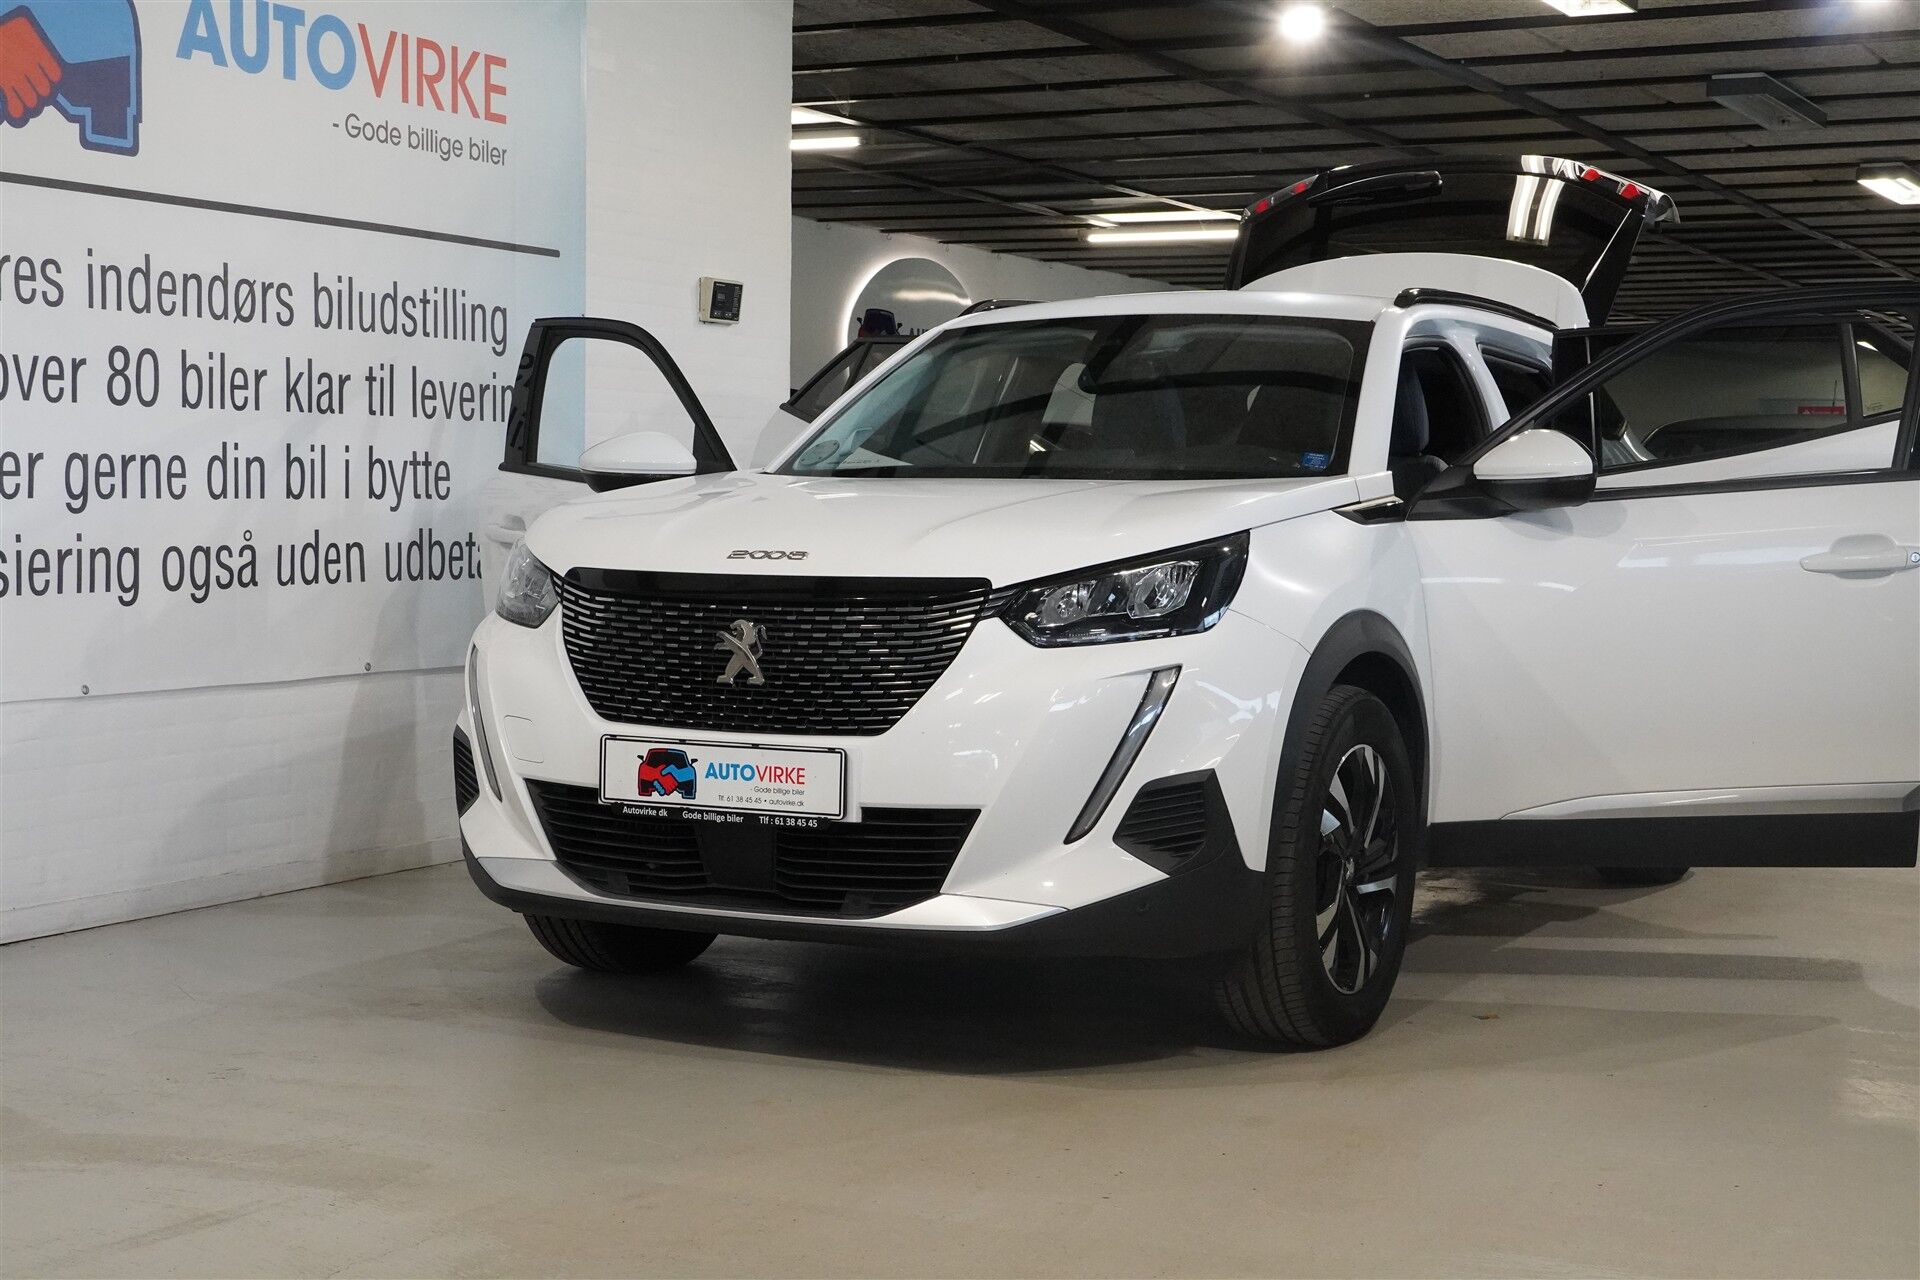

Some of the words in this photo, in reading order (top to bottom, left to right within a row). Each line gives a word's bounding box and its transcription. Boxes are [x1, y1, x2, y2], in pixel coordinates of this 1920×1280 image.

[176, 0, 507, 124] AUTOVIRKE
[345, 113, 402, 147] Gode
[408, 124, 464, 162] billige
[469, 137, 507, 166] biler
[87, 247, 295, 330] indendørs
[313, 272, 508, 358] biludstilling
[106, 345, 160, 408] 80
[181, 348, 268, 412] biler
[285, 356, 352, 416] klar
[364, 362, 395, 417] til
[64, 452, 187, 515] gerne
[206, 441, 266, 501] din
[285, 442, 326, 501] bil
[344, 444, 350, 499] i
[368, 445, 451, 513] bytte
[161, 529, 259, 604] også
[276, 529, 366, 587] uden
[727, 550, 809, 560] 2008
[705, 762, 806, 785] AUTOVIRKE
[754, 786, 772, 794] Gode
[773, 787, 791, 796] billige
[682, 810, 702, 820] Gode
[703, 812, 725, 823] billige
[726, 814, 744, 823] biler
[774, 817, 784, 826] 61
[786, 817, 796, 826] 38
[796, 818, 807, 827] 45
[808, 819, 818, 828] 45
